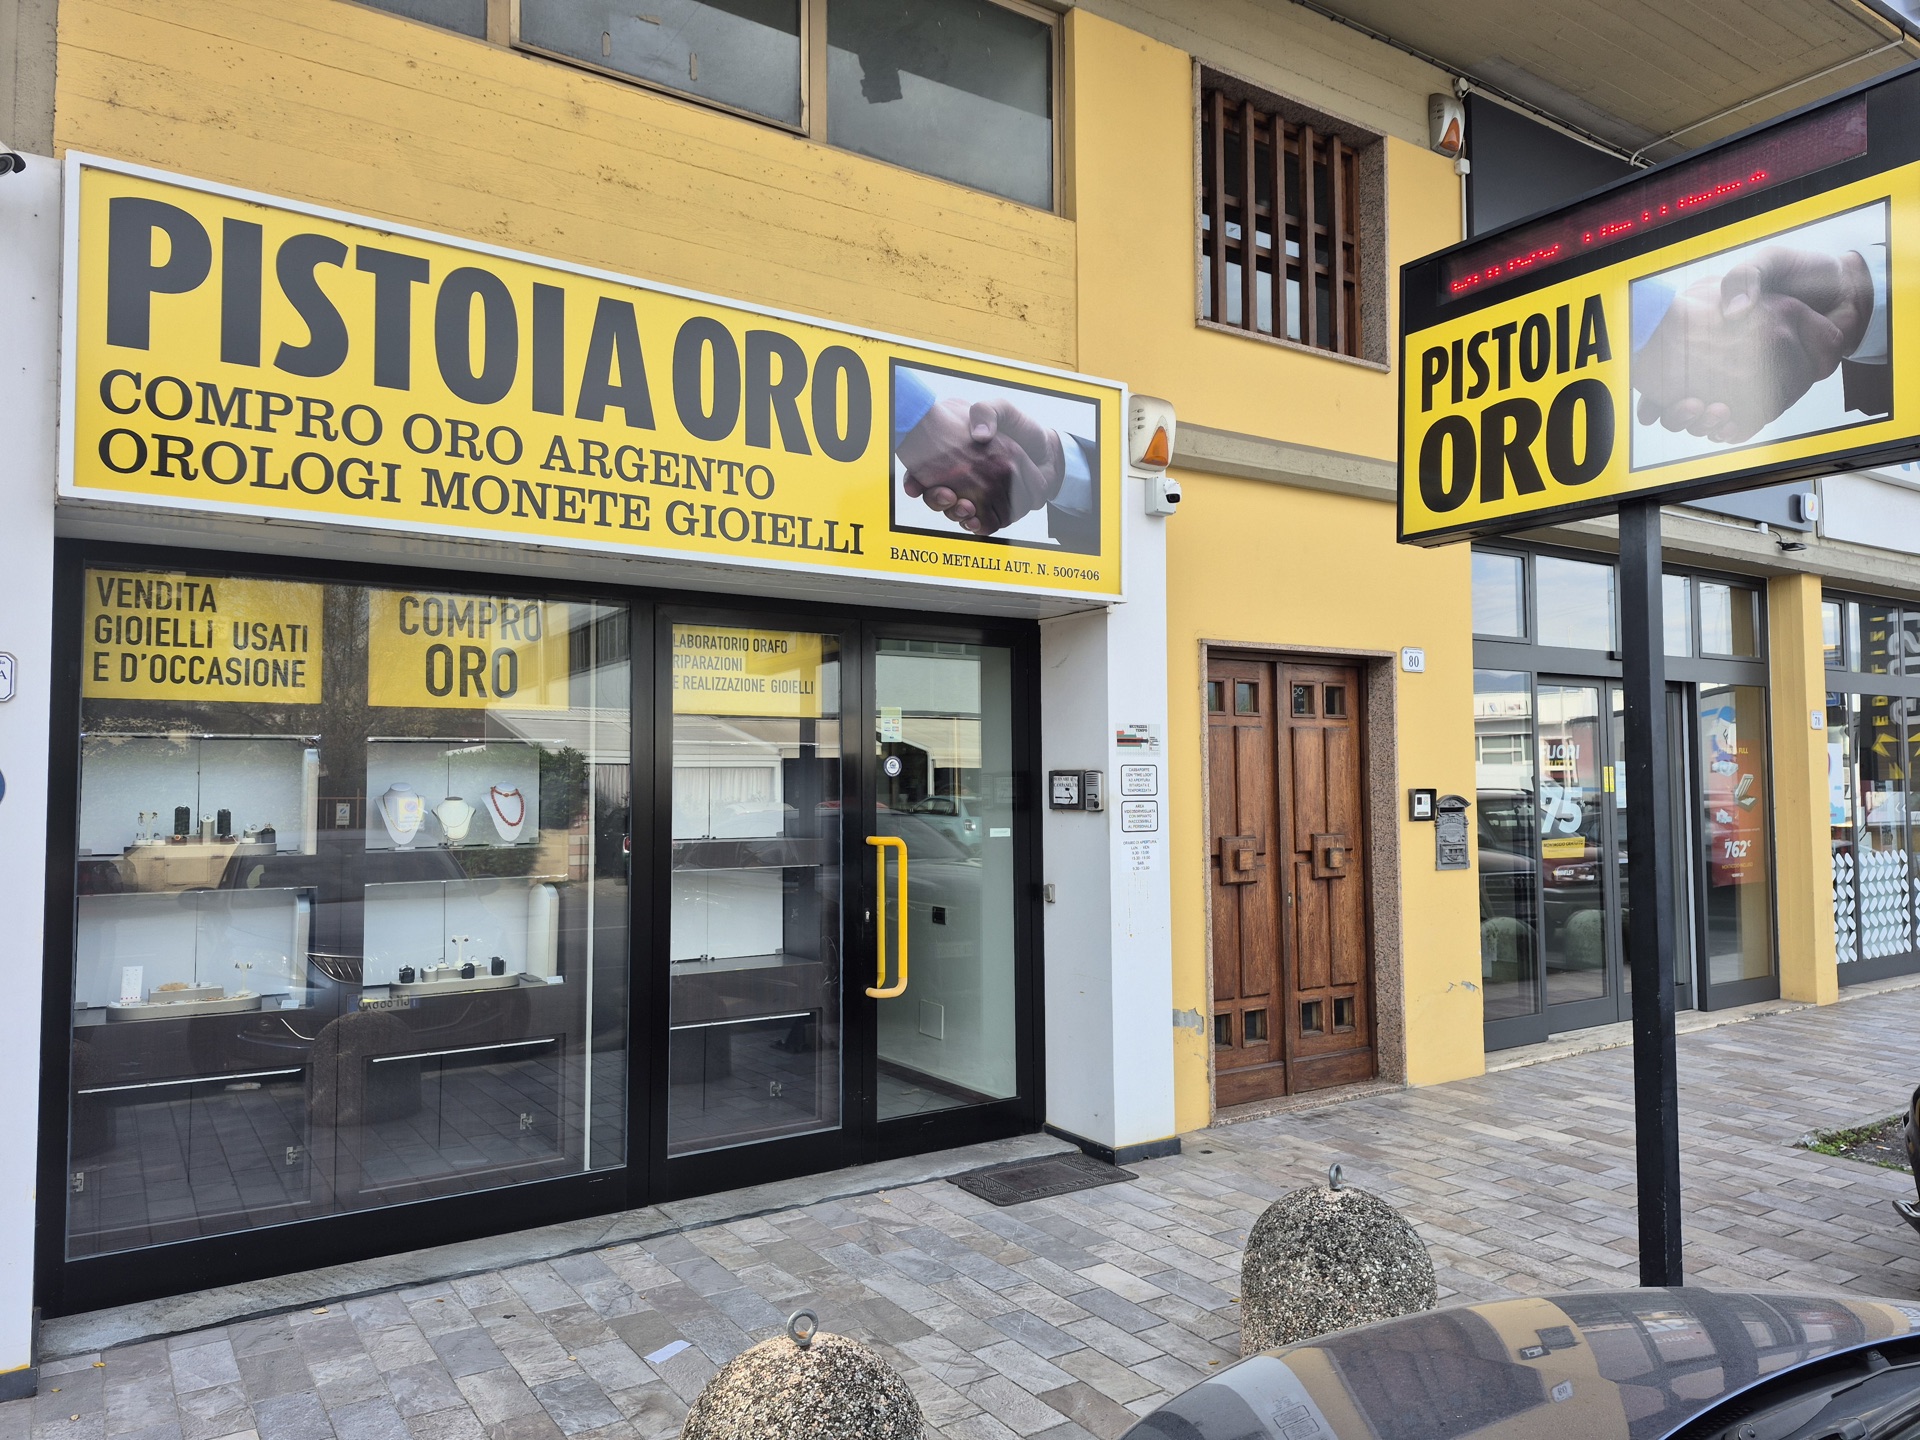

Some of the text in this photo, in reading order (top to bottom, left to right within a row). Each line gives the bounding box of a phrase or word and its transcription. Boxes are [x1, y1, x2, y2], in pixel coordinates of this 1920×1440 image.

[106, 196, 873, 463] PISTOIA ORO
[1421, 293, 1612, 413] PISTOIA
[99, 368, 775, 500] COMPRO ORO ARGENTO
[1418, 378, 1616, 513] ORO
[98, 428, 865, 555] OROLOGI MONETE GIOIELLI
[890, 547, 1100, 581] BANCO METALLI AUT. N. 5007406
[96, 576, 218, 613] VENDITA
[94, 614, 308, 653] GIOIELLI USATI
[399, 595, 542, 642] COMPRO
[673, 633, 788, 654] LABORATORIO ORAFO
[673, 654, 743, 672] RIPARAZIONI
[1408, 655, 1420, 668] 80
[93, 651, 306, 688] E D'OCCASIONE
[425, 643, 518, 699] ORO
[673, 675, 814, 695] E REALIZZAZIONE GIOIELLI
